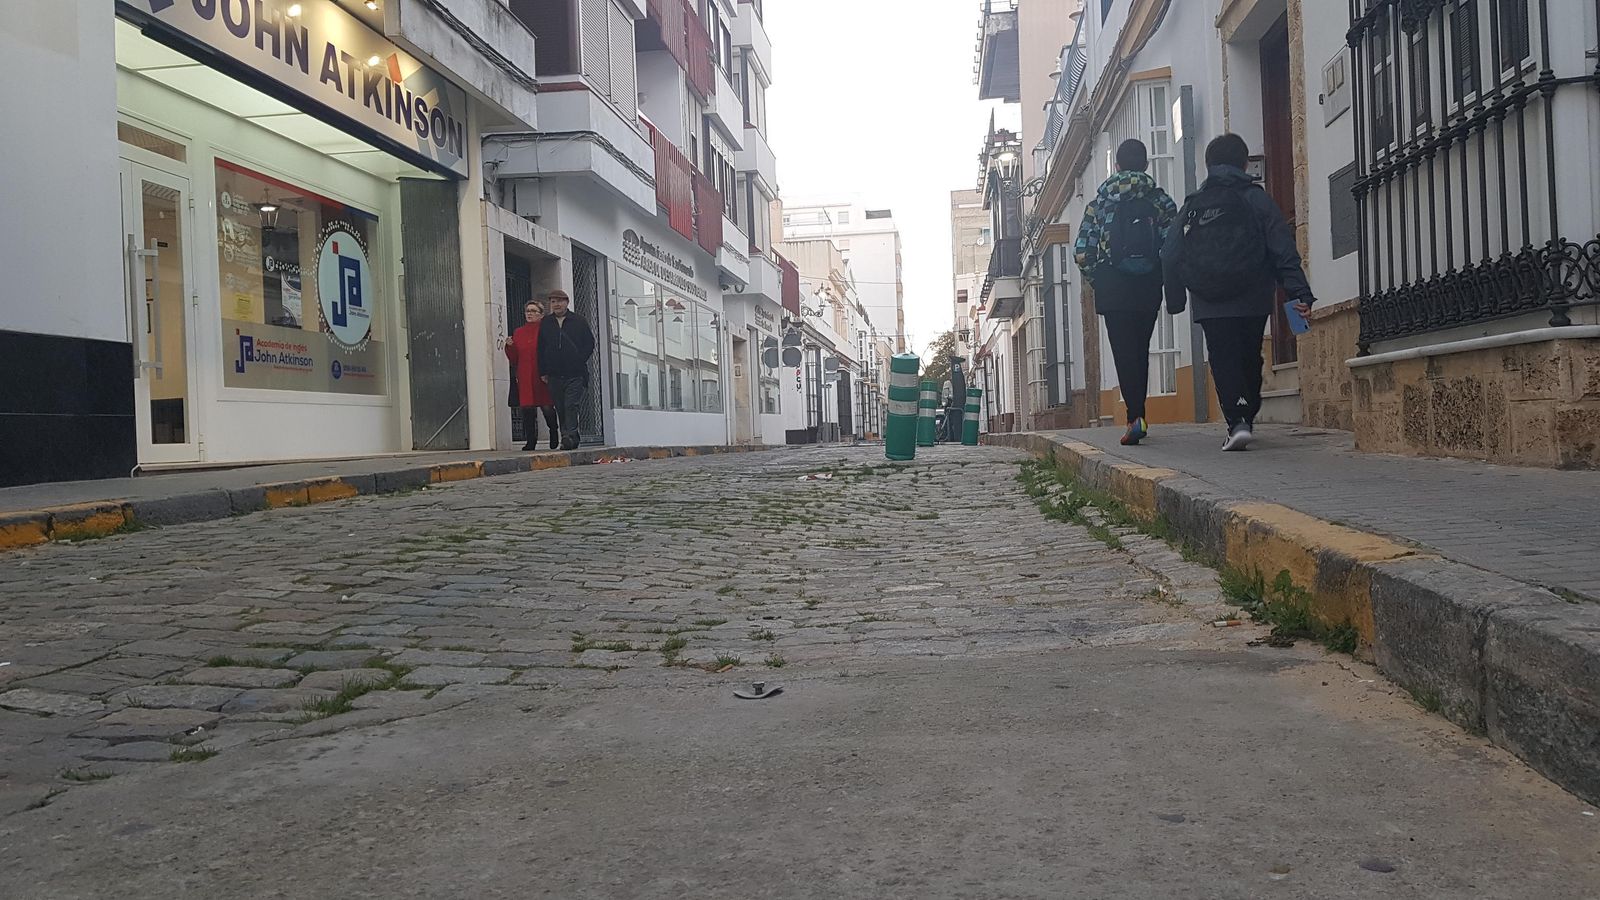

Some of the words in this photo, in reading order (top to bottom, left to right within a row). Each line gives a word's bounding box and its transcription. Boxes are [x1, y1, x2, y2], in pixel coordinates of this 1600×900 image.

[319, 41, 463, 159] ATKINSON
[256, 338, 285, 351] Academia
[285, 341, 293, 351] de
[254, 349, 278, 363] John
[278, 351, 314, 367] Atkinson
